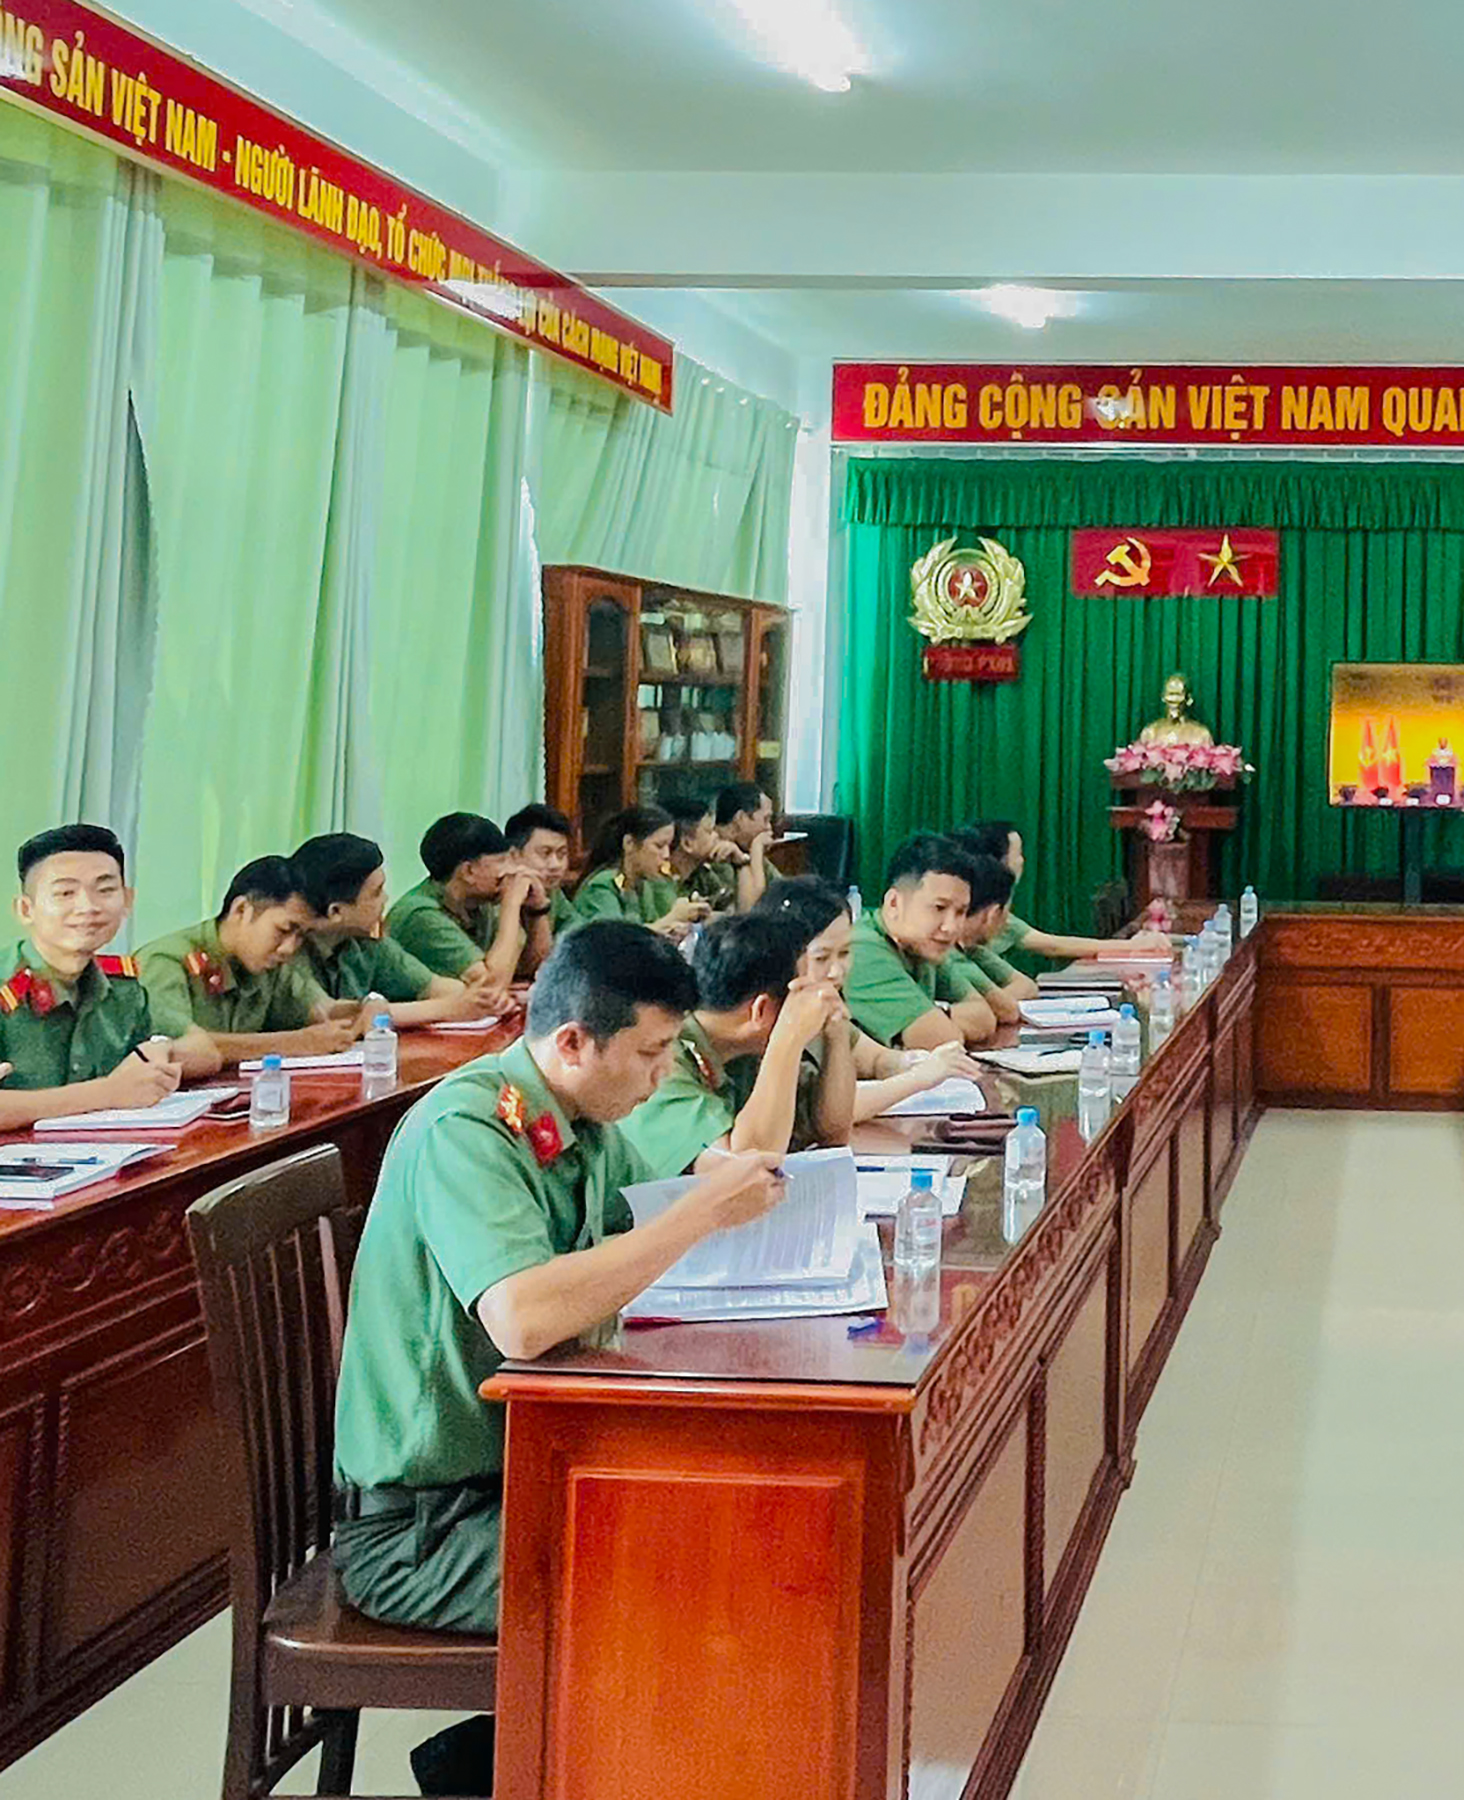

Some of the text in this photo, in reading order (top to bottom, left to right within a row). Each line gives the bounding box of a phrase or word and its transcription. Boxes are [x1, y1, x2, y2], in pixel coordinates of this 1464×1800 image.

[0, 8, 44, 86] NG
[50, 30, 104, 116] SẢN
[111, 71, 162, 146] VIỆT
[166, 98, 217, 172] NAM
[235, 134, 295, 210] NGƯỜI
[298, 166, 344, 235] LÃNH
[387, 203, 406, 264] TỔ
[864, 367, 967, 430] ĐẢNG
[979, 373, 1081, 439] CỘNG
[1189, 375, 1269, 440] VIỆT
[1281, 385, 1370, 431] NAM
